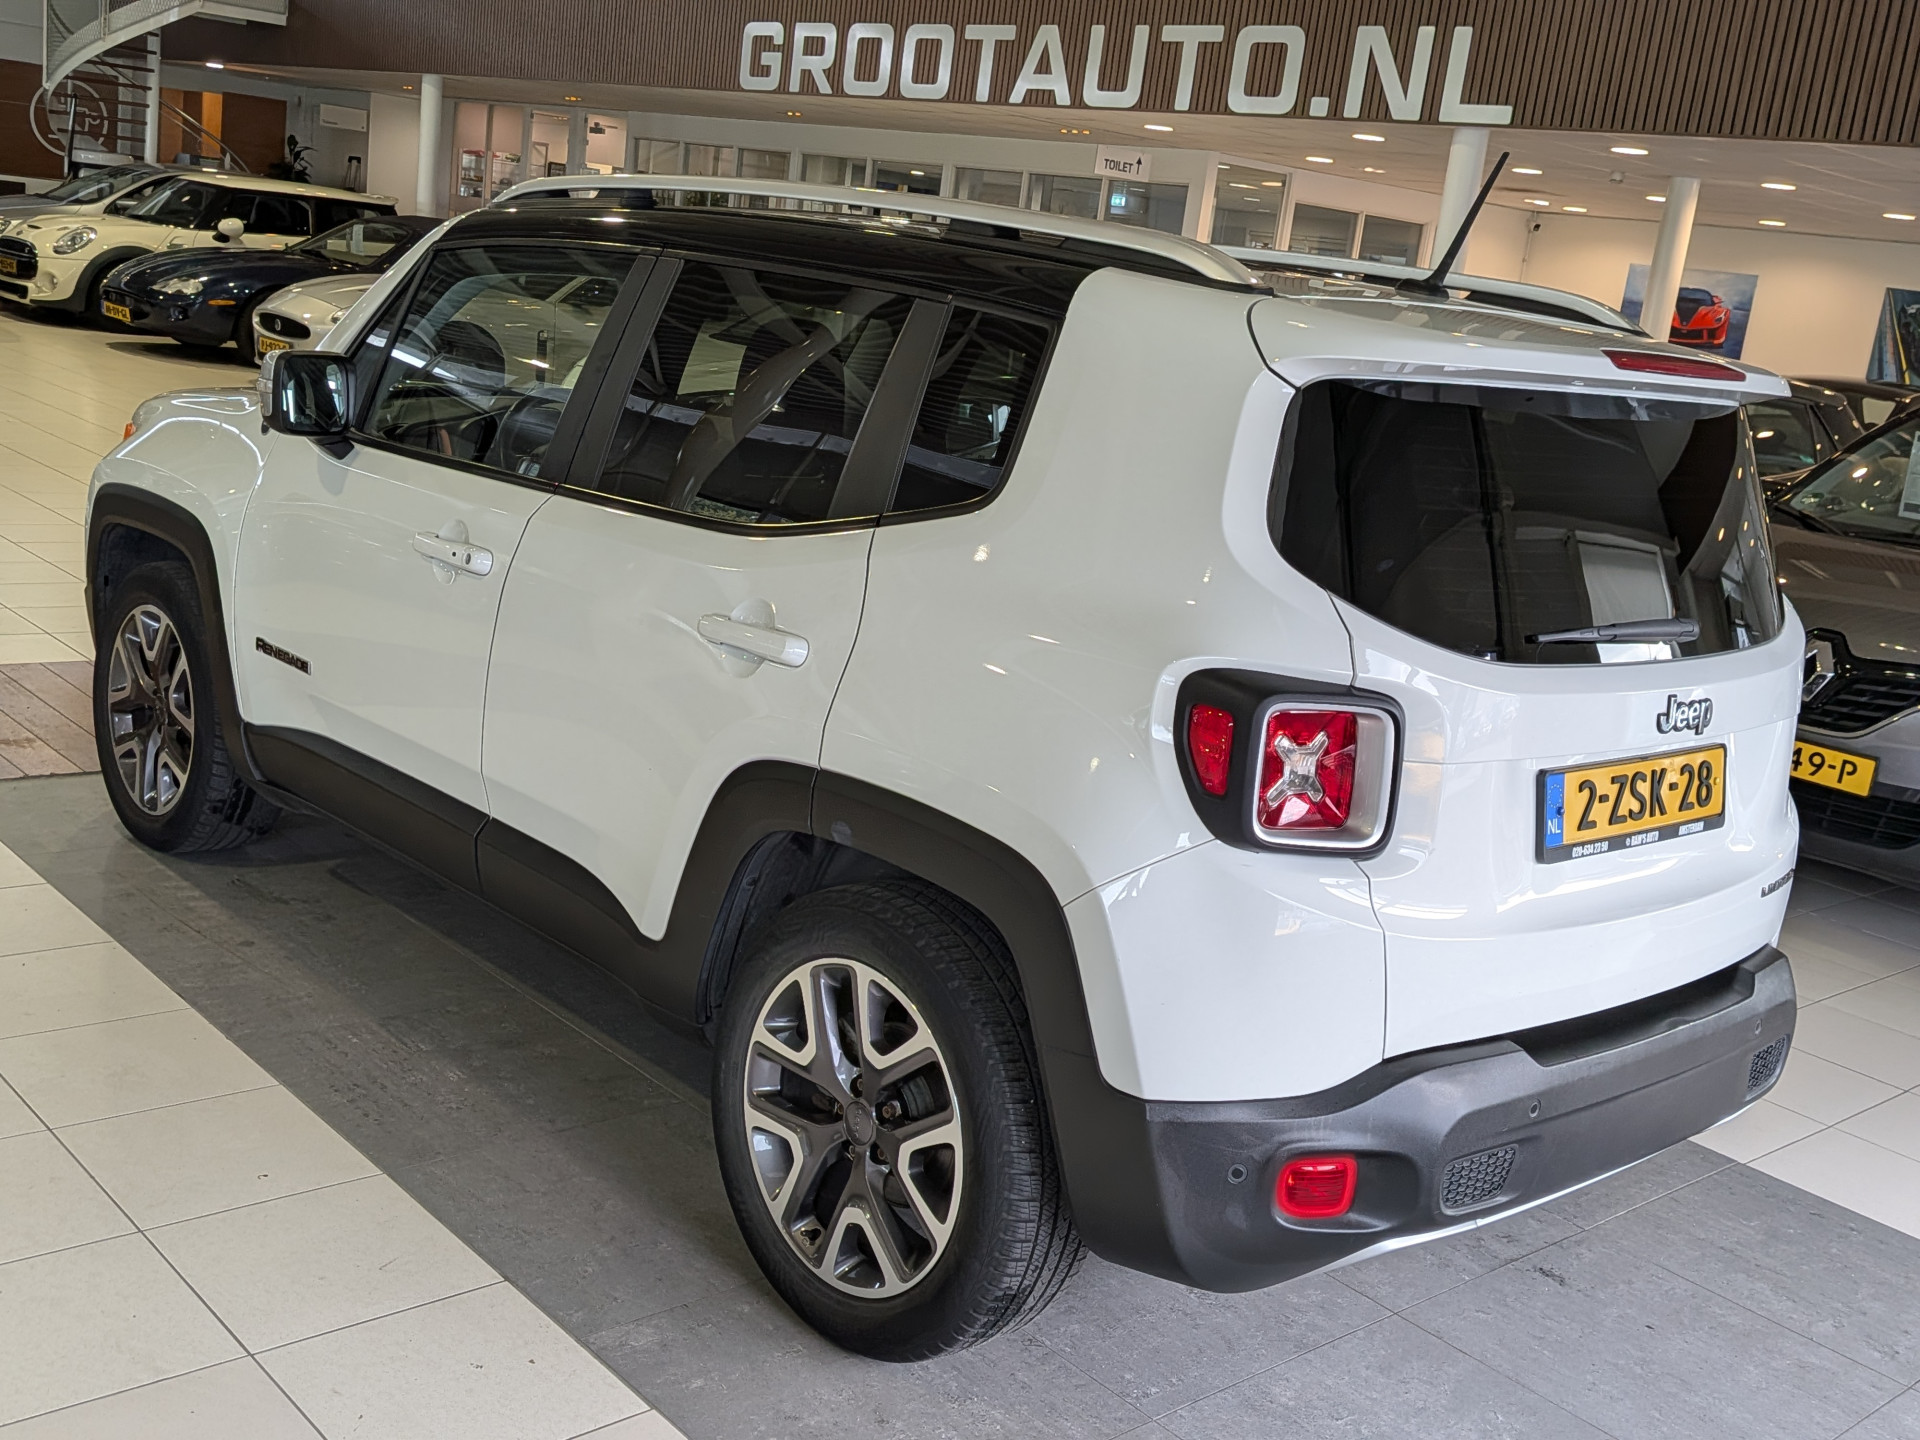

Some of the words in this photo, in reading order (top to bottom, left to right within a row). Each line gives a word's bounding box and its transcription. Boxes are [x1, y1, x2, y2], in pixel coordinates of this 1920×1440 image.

[739, 21, 1513, 125] GROOTAUTO.NL
[1103, 158, 1134, 174] TOILET
[255, 636, 311, 676] RENEGADE
[1656, 693, 1713, 736] Jeep
[1576, 759, 1713, 832] 2-ZSK-28
[1548, 818, 1561, 835] NL
